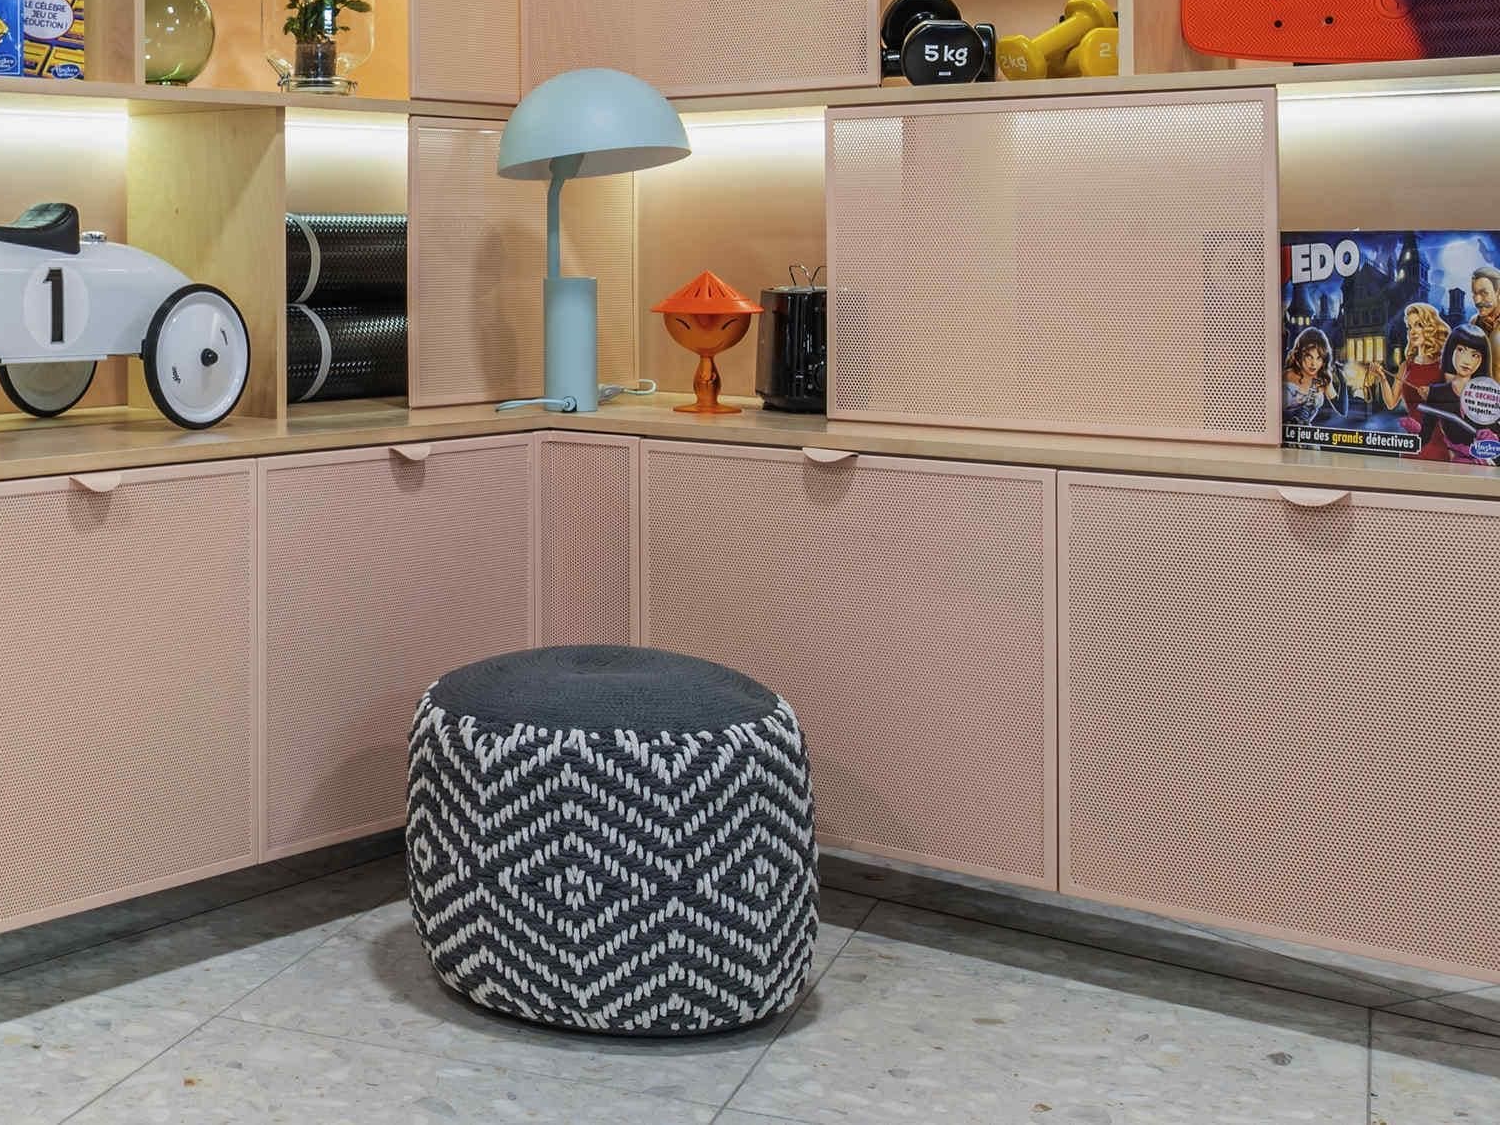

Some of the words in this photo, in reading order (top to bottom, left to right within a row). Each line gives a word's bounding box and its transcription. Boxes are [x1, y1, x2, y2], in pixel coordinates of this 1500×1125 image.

[31, 9, 47, 19] JEU
[47, 12, 58, 20] DE
[924, 44, 939, 63] 5
[943, 44, 969, 66] kg
[43, 267, 65, 344] 1
[1285, 426, 1296, 438] Le
[1297, 428, 1311, 443] jeu
[1313, 429, 1330, 441] des
[1332, 432, 1364, 445] grands
[1365, 433, 1414, 449] détectives
